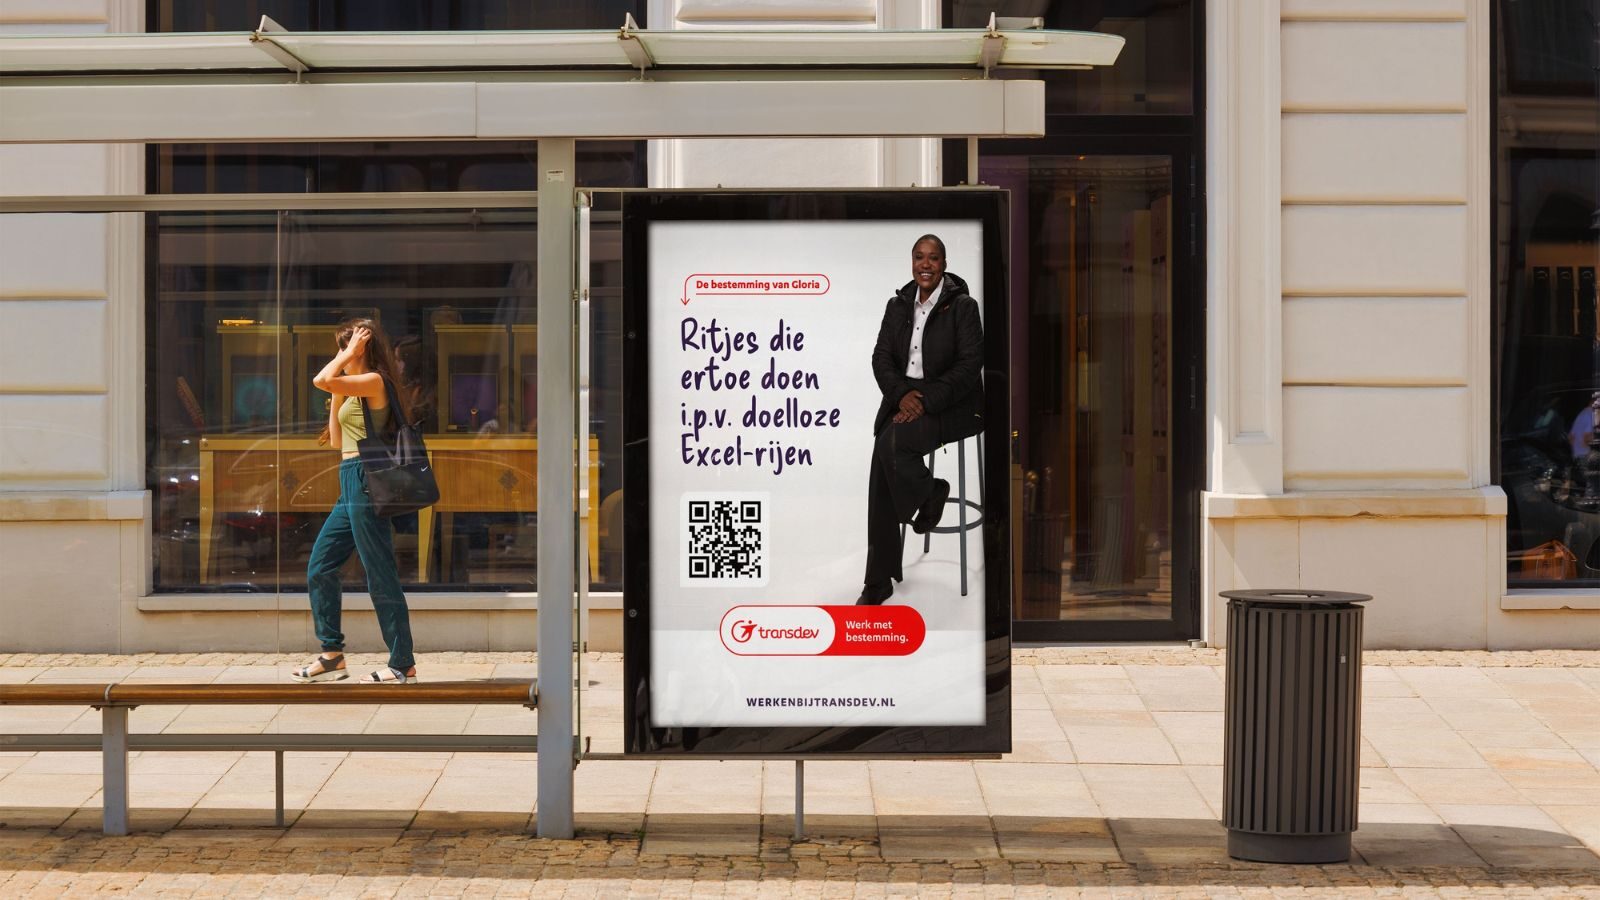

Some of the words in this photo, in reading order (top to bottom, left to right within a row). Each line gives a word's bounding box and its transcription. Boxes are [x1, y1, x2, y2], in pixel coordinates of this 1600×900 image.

[696, 280, 709, 289] De
[711, 280, 770, 291] bestemming
[791, 280, 820, 289] Gloria
[681, 317, 759, 361] Ritjes
[769, 318, 804, 351] die
[681, 356, 750, 391] ertoe
[761, 356, 819, 390] doen
[681, 402, 732, 442] i.p.v.
[742, 394, 840, 428] doelloze
[681, 433, 813, 475] Excel-rijen
[845, 620, 871, 629] Werk
[873, 620, 893, 629] met
[758, 626, 819, 639] transdev
[845, 632, 909, 643] bestemming.
[746, 697, 896, 707] WERKENBIJTRANSDEV.NL
